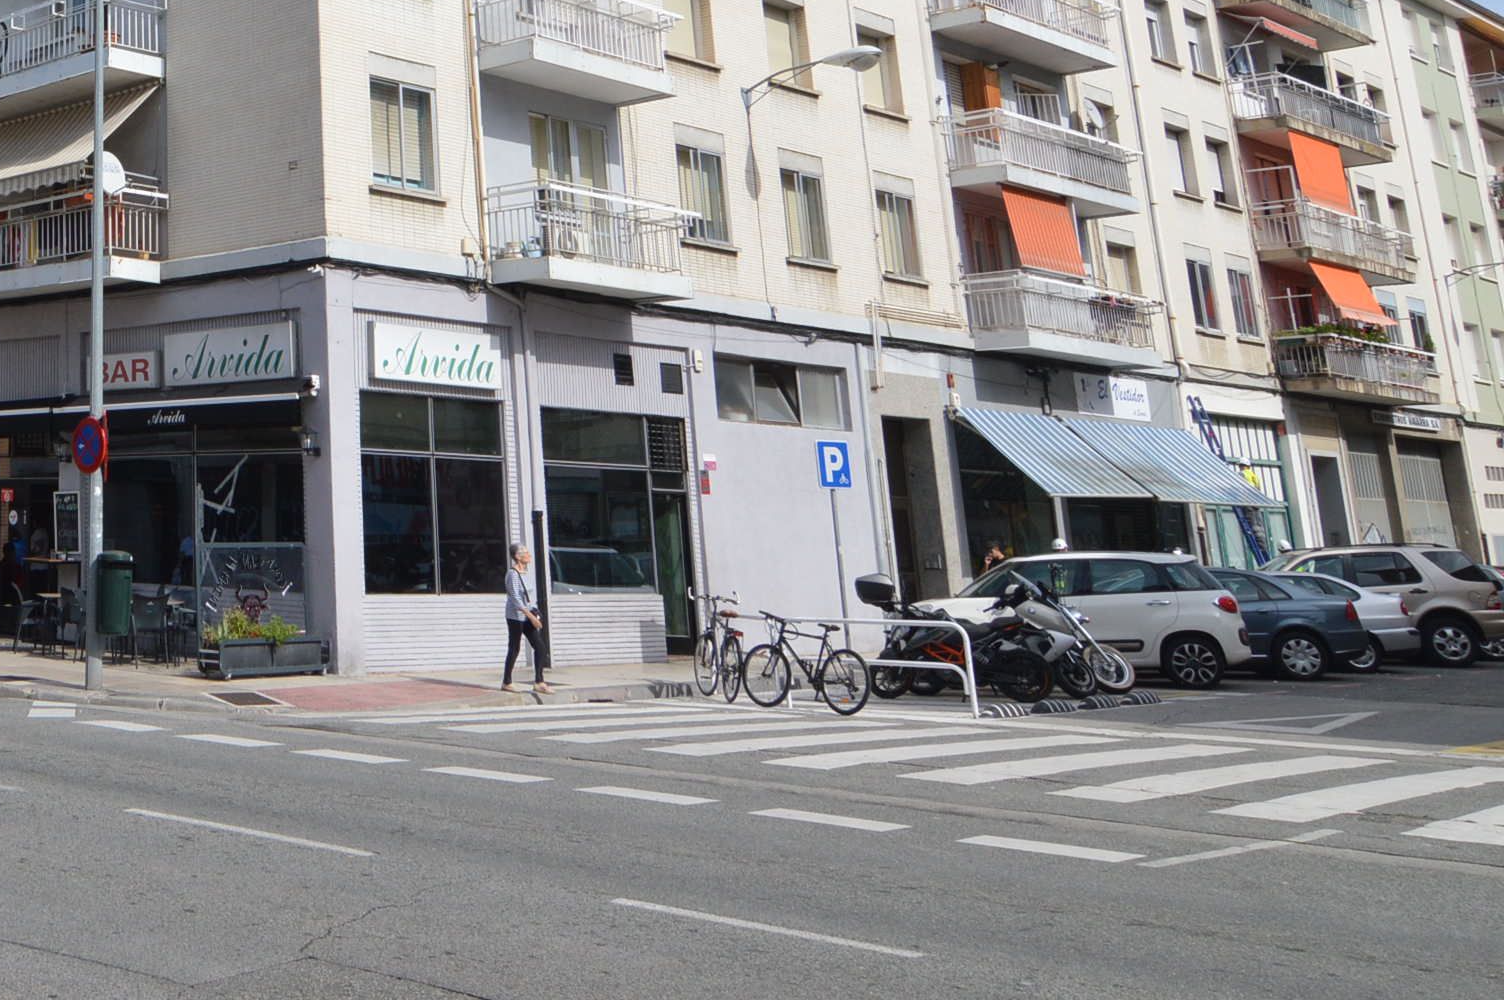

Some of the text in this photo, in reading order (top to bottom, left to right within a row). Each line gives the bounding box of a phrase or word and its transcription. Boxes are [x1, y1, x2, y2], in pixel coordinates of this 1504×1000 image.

[172, 333, 285, 382] Arvida
[384, 331, 494, 383] Arvida
[1111, 382, 1146, 403] Vestidor
[147, 409, 185, 425] Arvida
[822, 445, 844, 483] P
